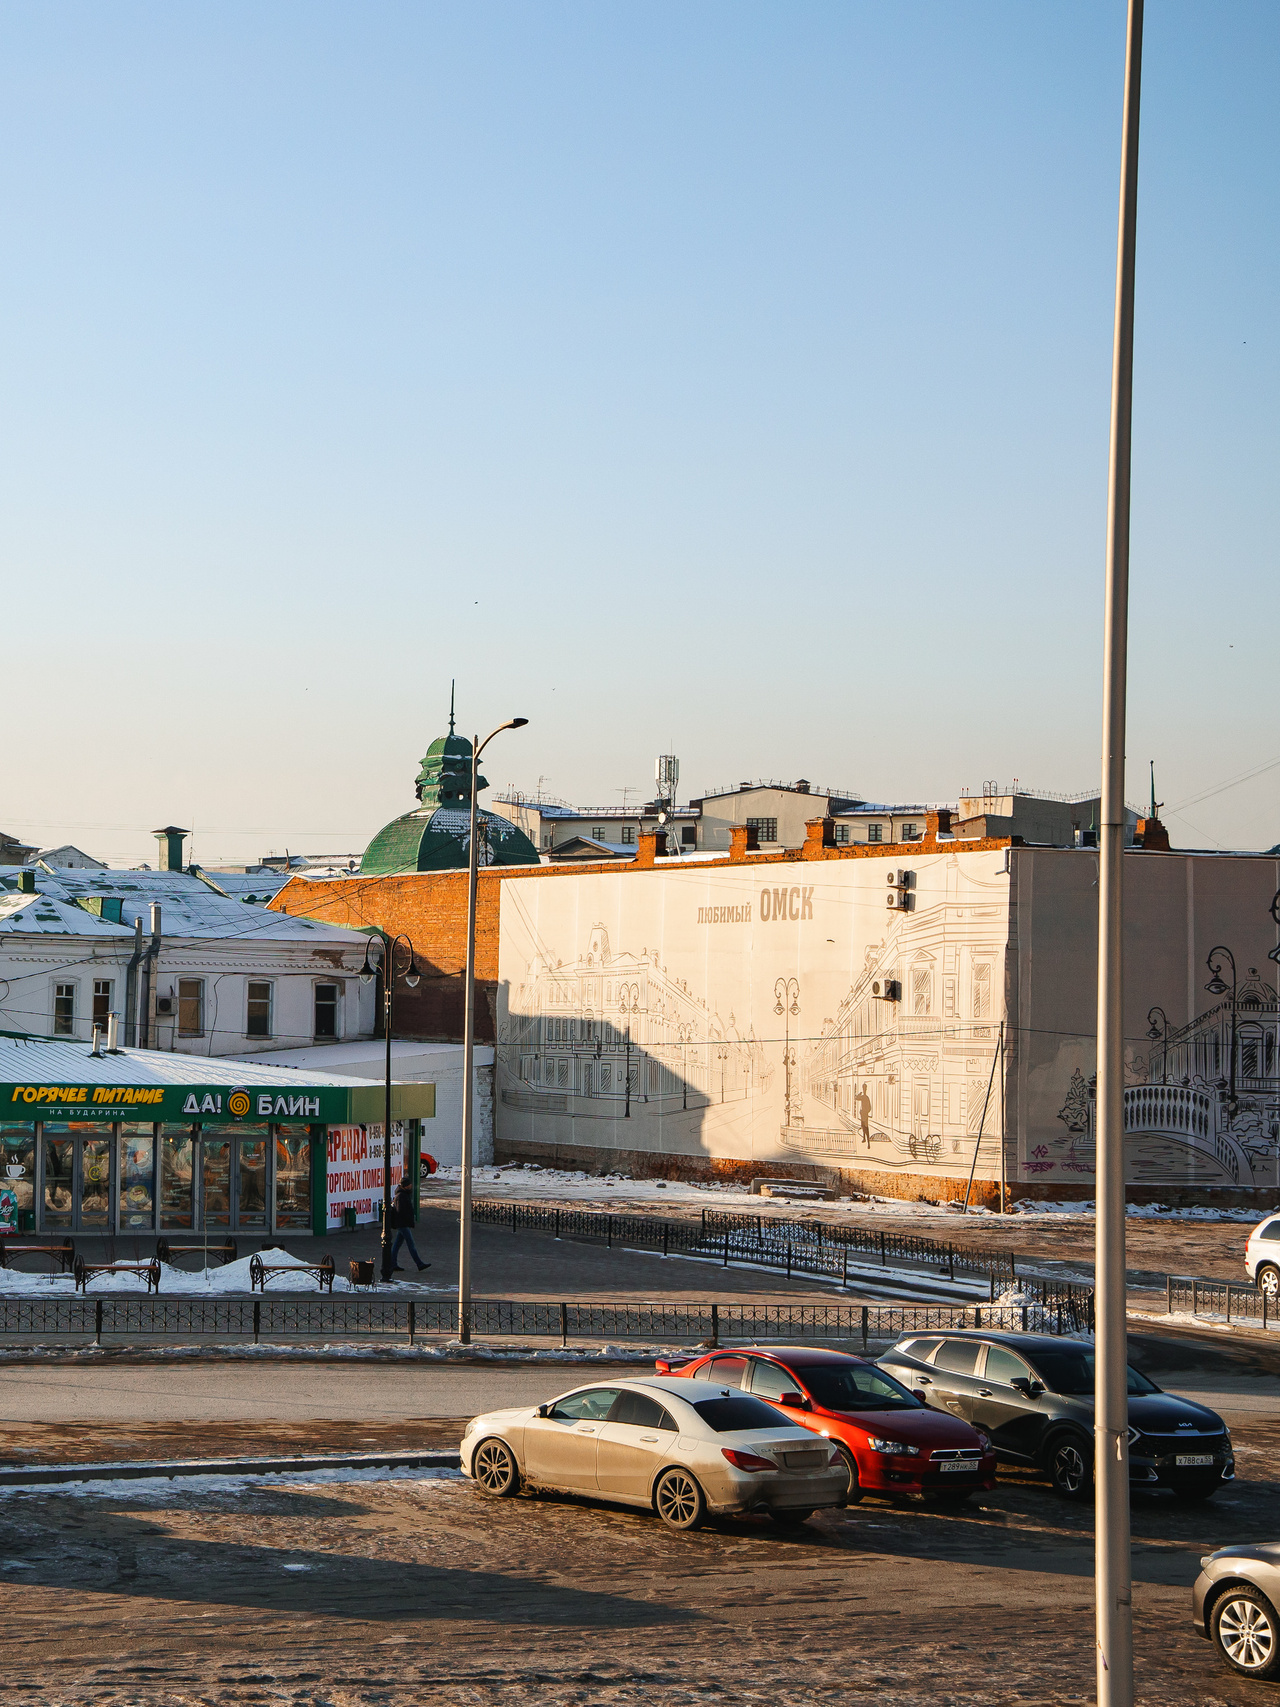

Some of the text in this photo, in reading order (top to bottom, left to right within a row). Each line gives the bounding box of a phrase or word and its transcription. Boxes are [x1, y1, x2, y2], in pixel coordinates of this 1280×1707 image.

[697, 887, 815, 924] ЛЮБИМЫЙ ОМСК
[11, 1087, 165, 1104] ГОРЯЧЕЕ ПИТАНИЕ
[182, 1093, 320, 1117] ДА! БЛИН
[327, 1129, 368, 1164] АРЕНДА
